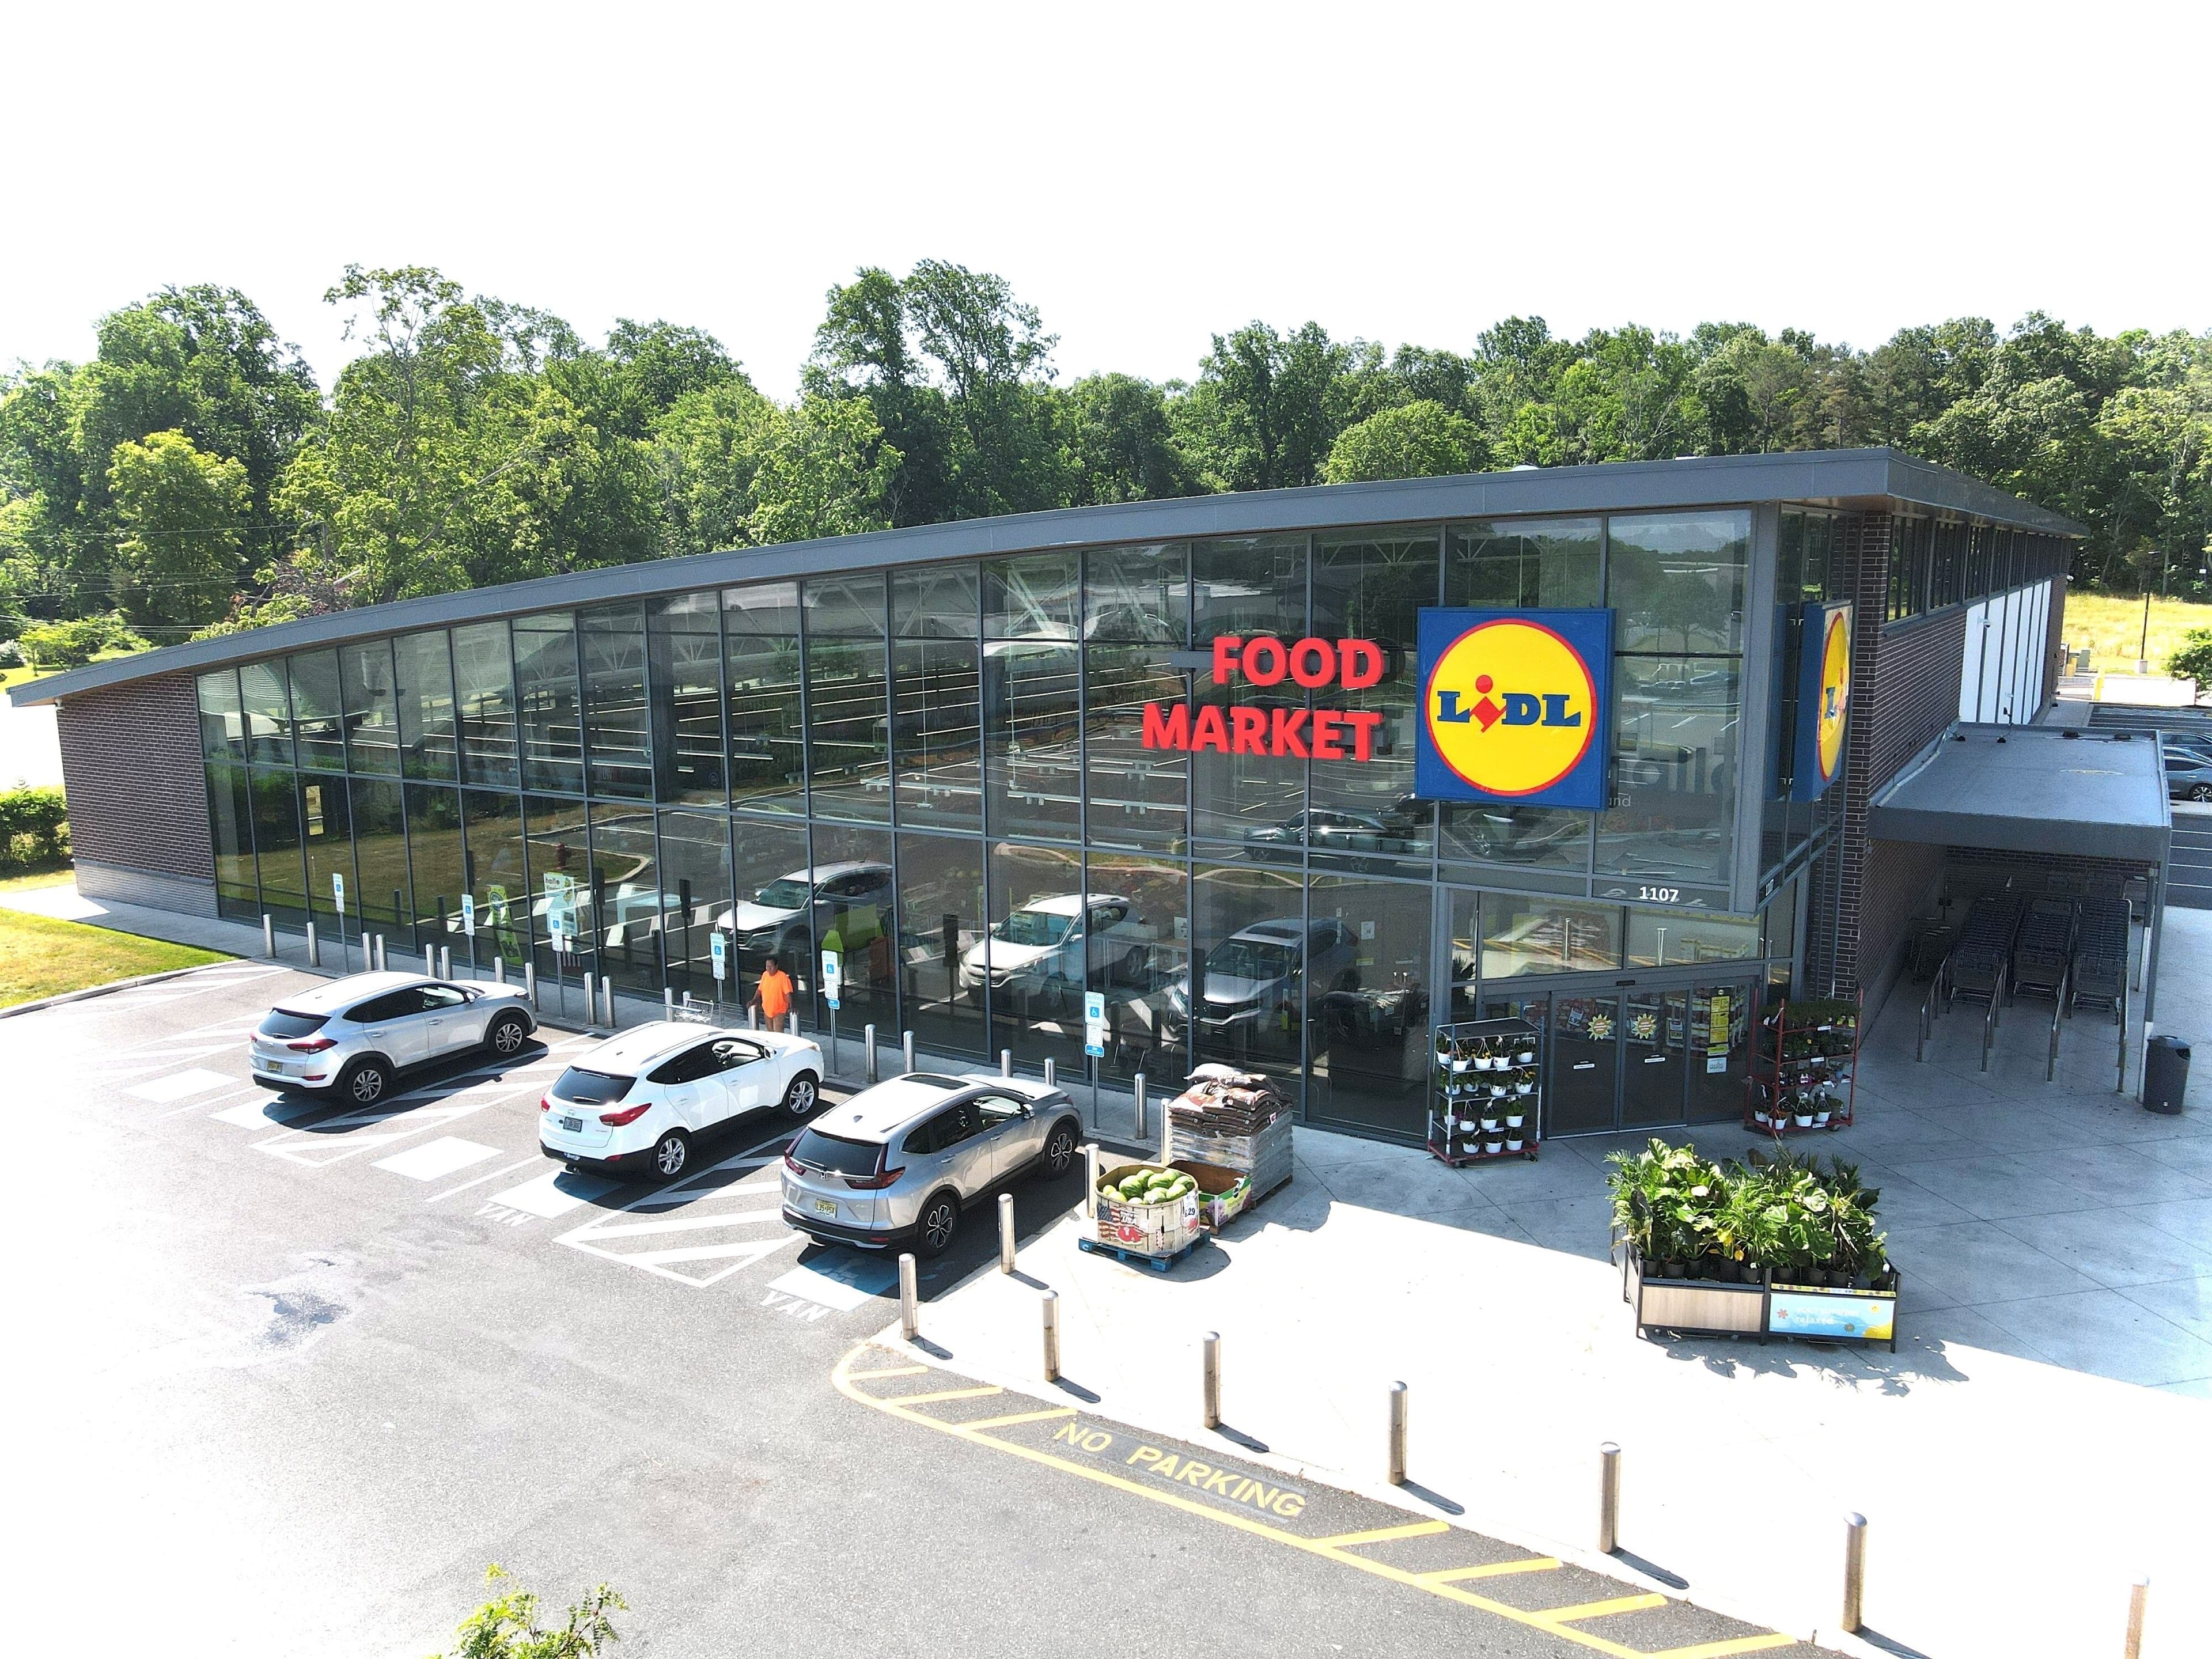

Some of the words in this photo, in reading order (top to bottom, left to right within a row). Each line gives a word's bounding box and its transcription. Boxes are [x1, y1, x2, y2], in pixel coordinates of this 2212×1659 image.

[1213, 636, 1384, 689] FOOD
[1142, 703, 1383, 763] MARKET
[1639, 886, 1679, 903] 1107
[474, 1202, 535, 1227] VAN
[1121, 1216, 1137, 1225] USA
[759, 1290, 834, 1323] VAN
[1053, 1422, 1112, 1452] NO
[1126, 1446, 1306, 1516] PARKING
